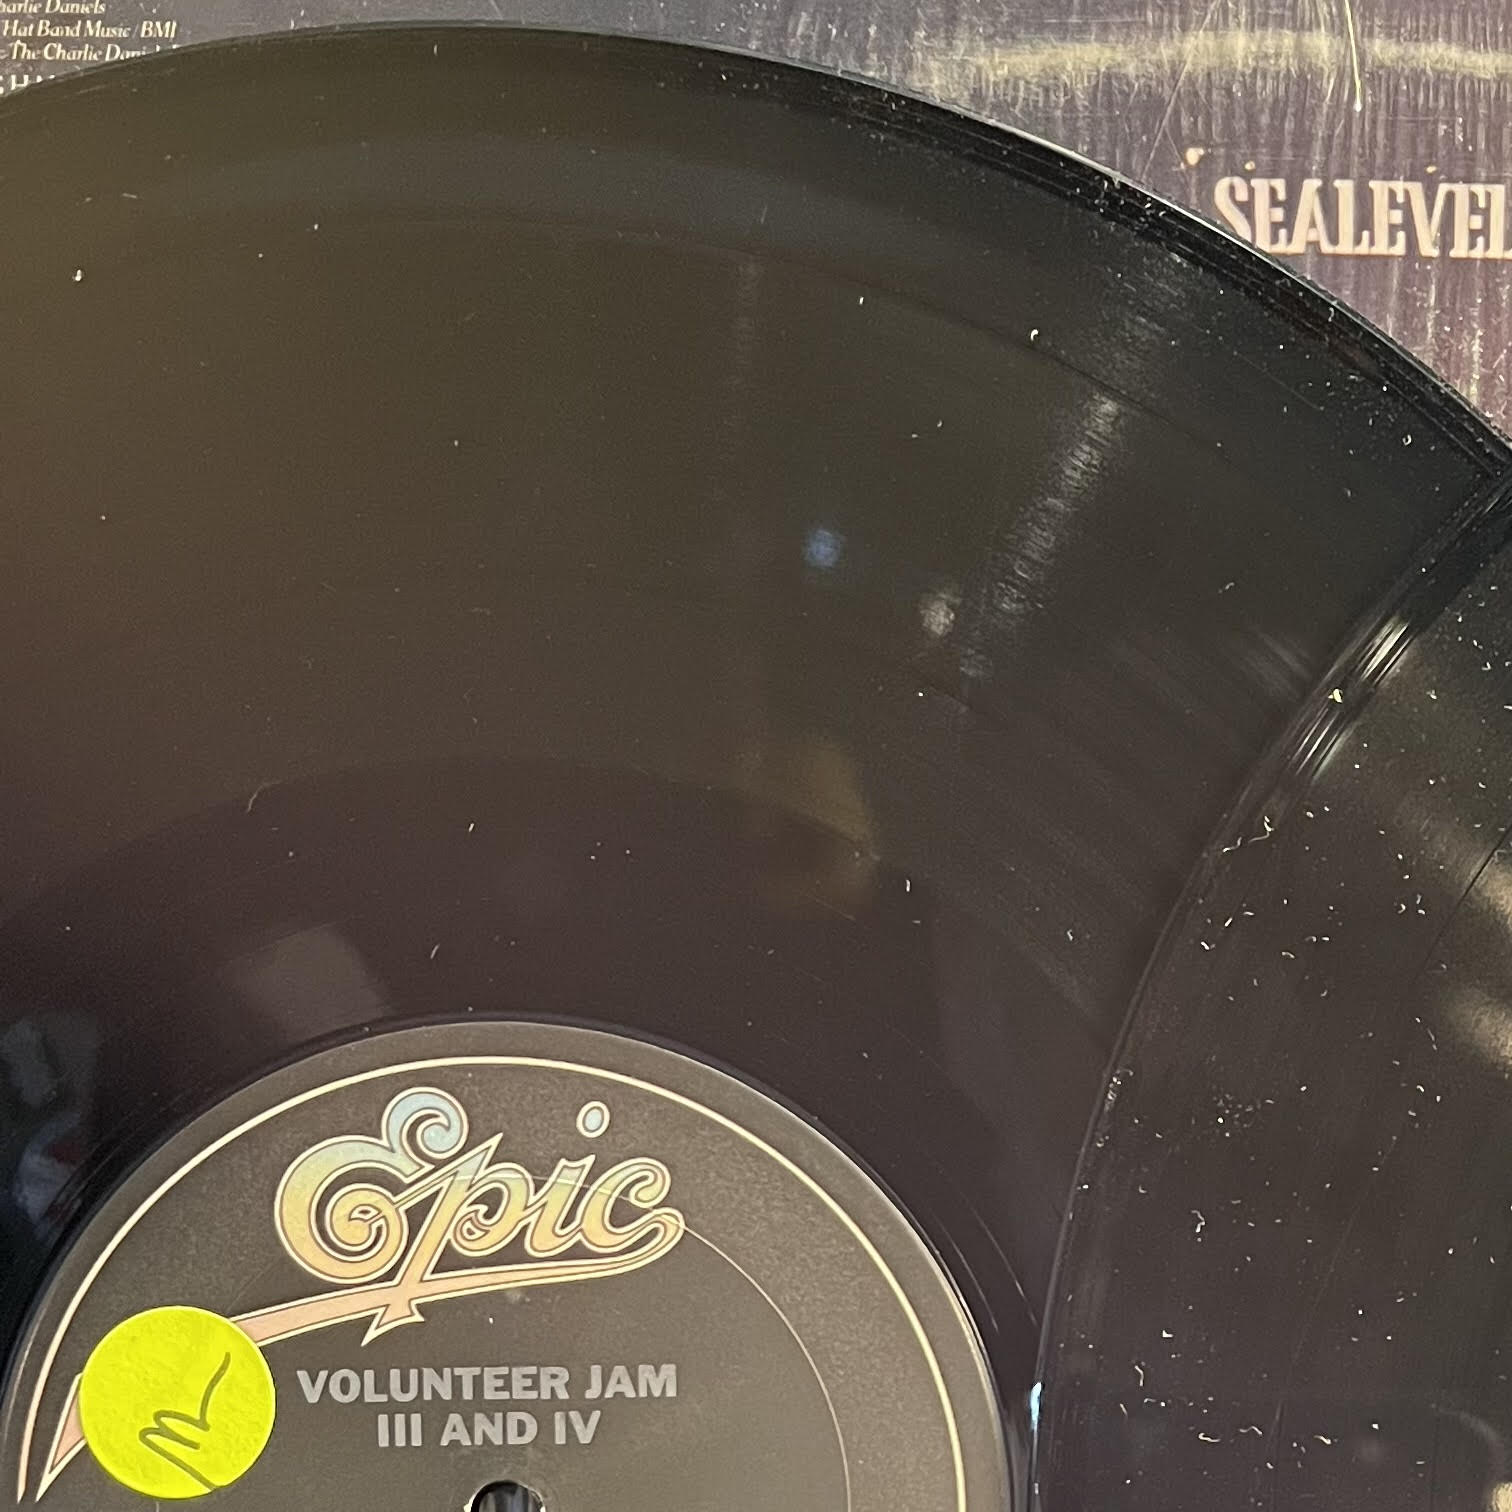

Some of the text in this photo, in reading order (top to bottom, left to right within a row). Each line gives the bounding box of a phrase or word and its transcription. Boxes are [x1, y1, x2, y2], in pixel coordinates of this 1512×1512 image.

[37, 20, 82, 37] Band
[84, 20, 131, 38] Music
[140, 20, 177, 38] BMI
[43, 42, 103, 61] Charlie
[297, 1363, 677, 1405] VOLUNTEER JAM
[377, 1409, 601, 1449] III AND IV
